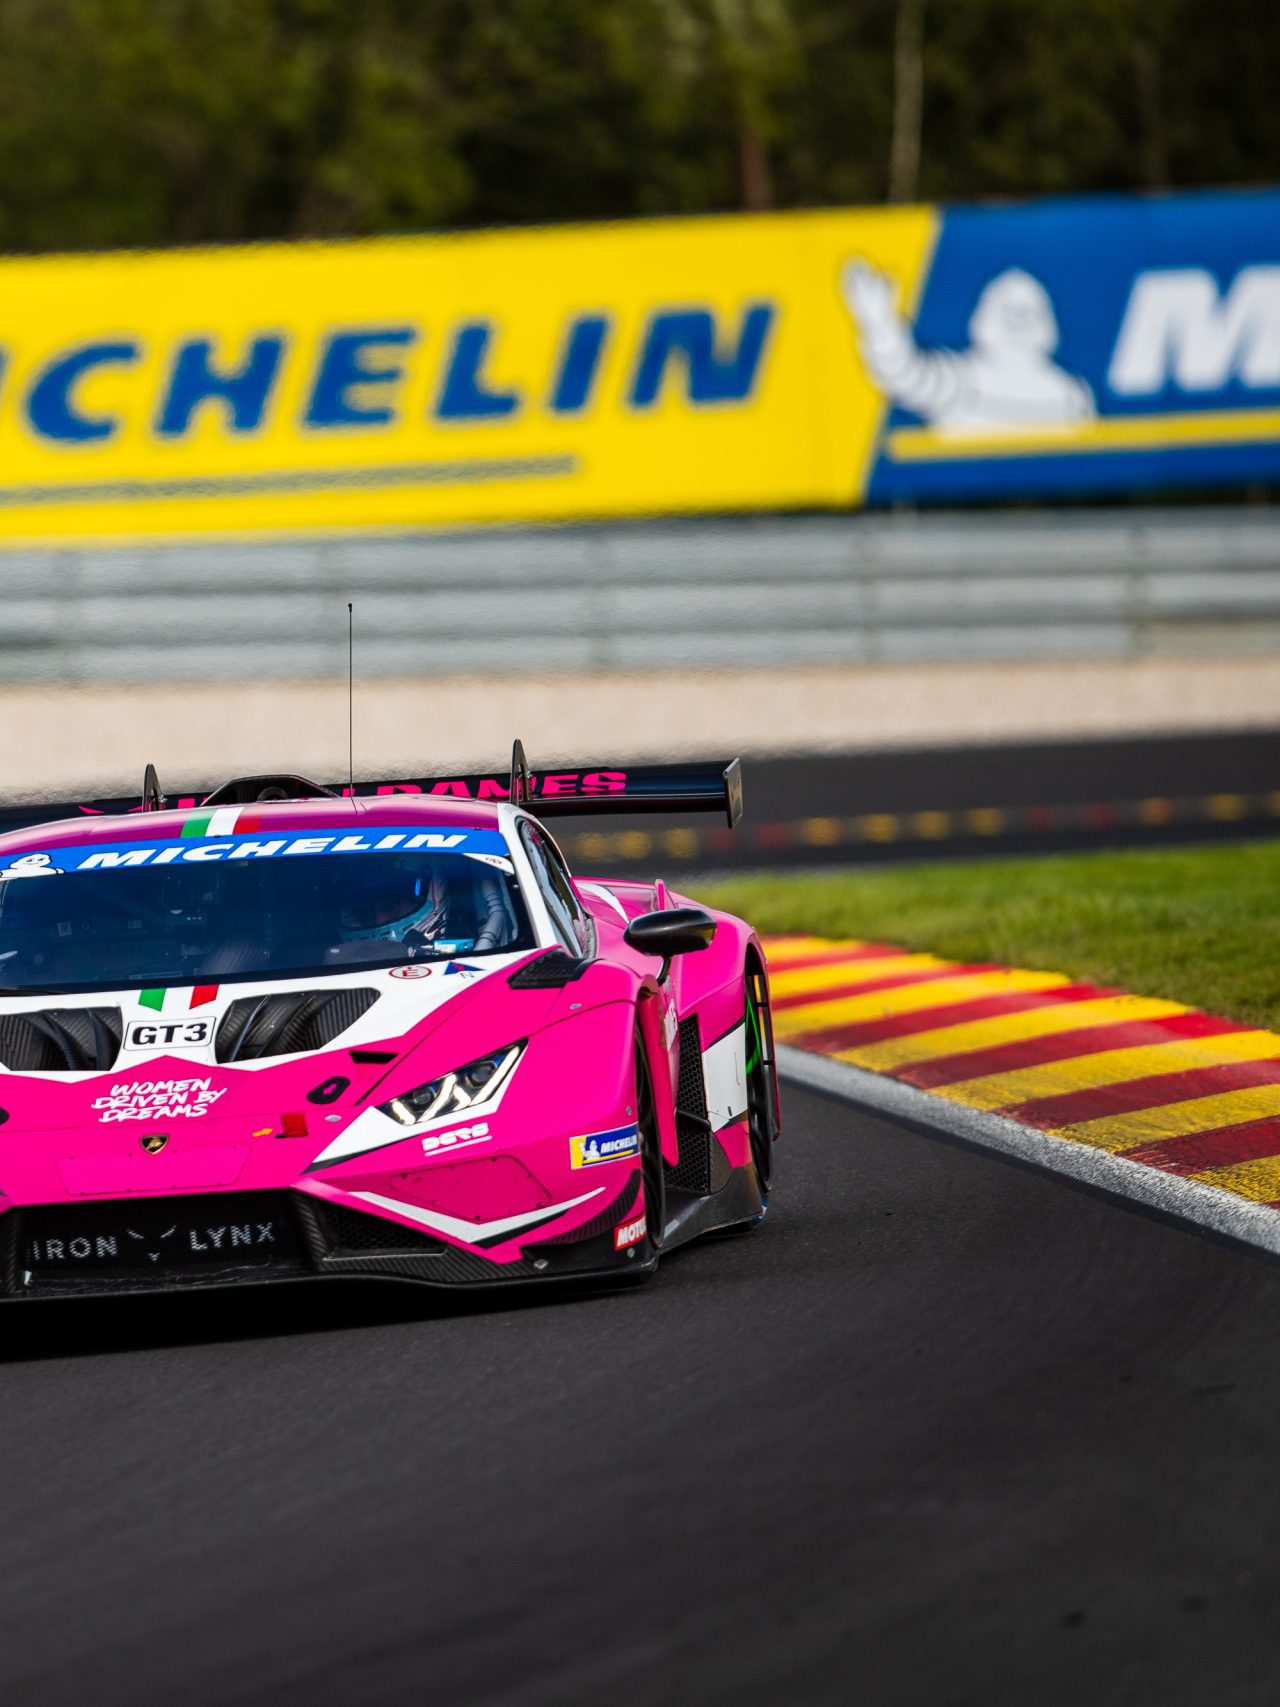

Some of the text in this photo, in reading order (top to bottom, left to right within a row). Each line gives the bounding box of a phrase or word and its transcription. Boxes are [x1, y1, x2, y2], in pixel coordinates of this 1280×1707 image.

[76, 834, 470, 870] MICHELIN
[131, 1022, 208, 1046] GT3
[110, 1077, 212, 1097] WOMEN
[91, 1088, 227, 1109] DRIVEN BY
[99, 1103, 208, 1123] DREAMS
[32, 1222, 275, 1260] IRON LYNX
